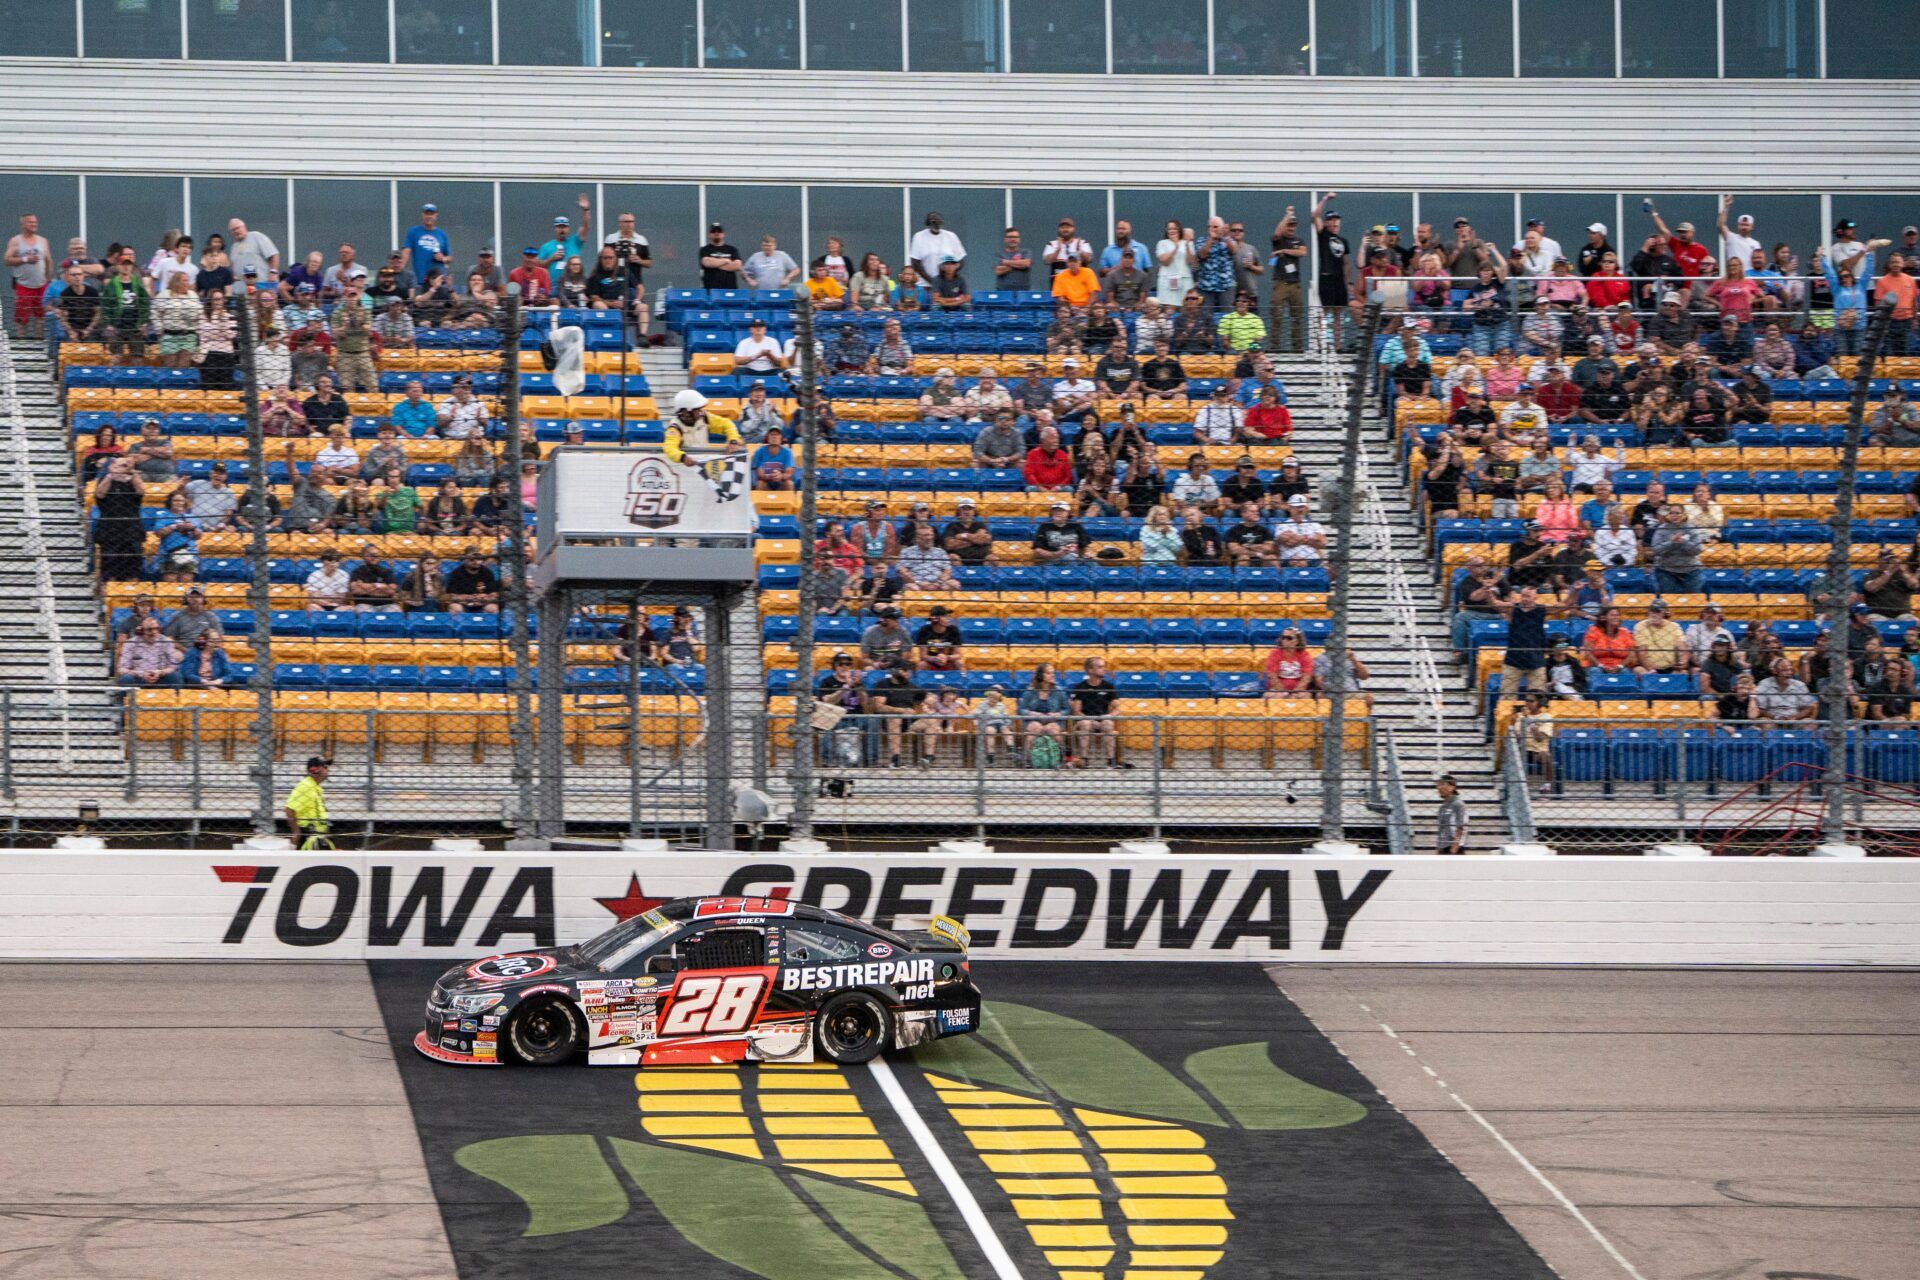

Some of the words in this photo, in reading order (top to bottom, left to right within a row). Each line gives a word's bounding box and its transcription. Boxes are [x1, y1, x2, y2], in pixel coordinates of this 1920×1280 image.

[624, 493, 687, 516] 150
[211, 865, 556, 947] IOWA
[872, 946, 893, 954] BRC
[783, 958, 935, 991] BESTREPAIR
[899, 980, 936, 1001] .net
[587, 1006, 609, 1014] UNOH
[660, 974, 768, 1037] 28
[942, 1007, 970, 1018] FOLSOM
[948, 1016, 970, 1026] FENCE
